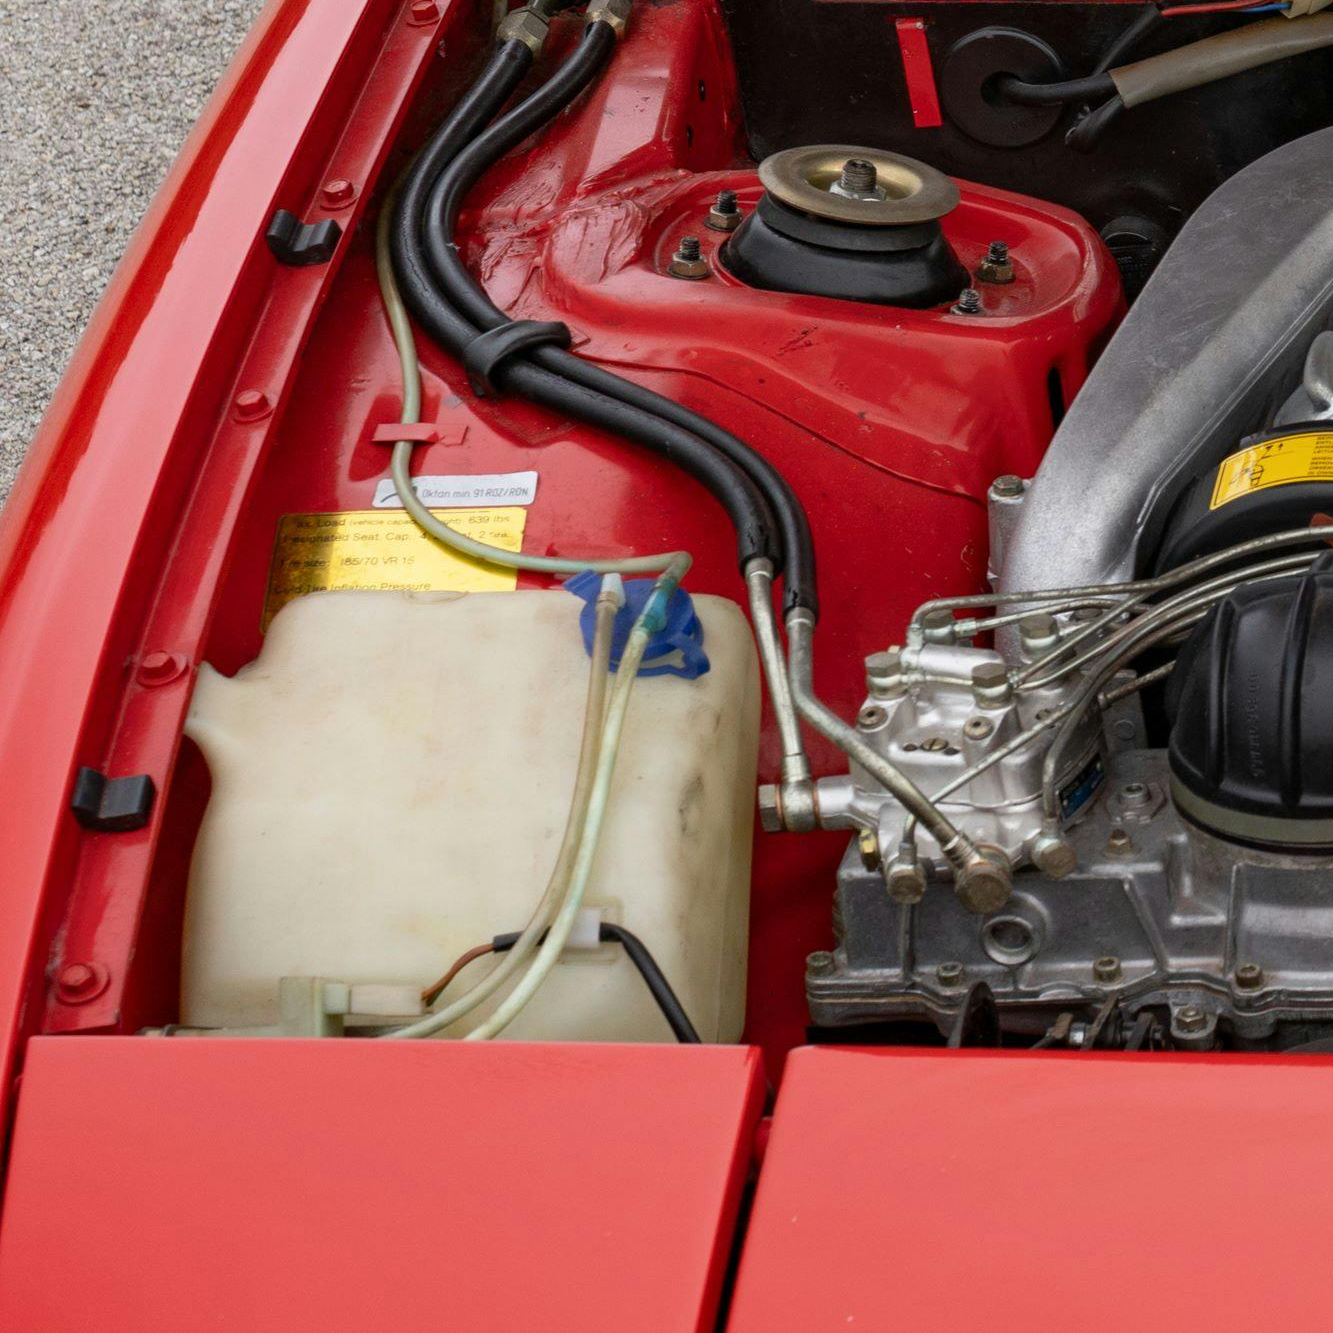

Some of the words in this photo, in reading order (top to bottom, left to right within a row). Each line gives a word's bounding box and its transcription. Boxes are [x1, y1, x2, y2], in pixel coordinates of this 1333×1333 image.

[473, 488, 484, 497] 91
[316, 518, 345, 528] Load
[468, 516, 490, 524] 639
[353, 532, 380, 542] Seat
[340, 556, 378, 566] 185/70
[383, 556, 399, 565] VR
[329, 582, 377, 592] Inflation
[380, 581, 432, 592] Pressure
